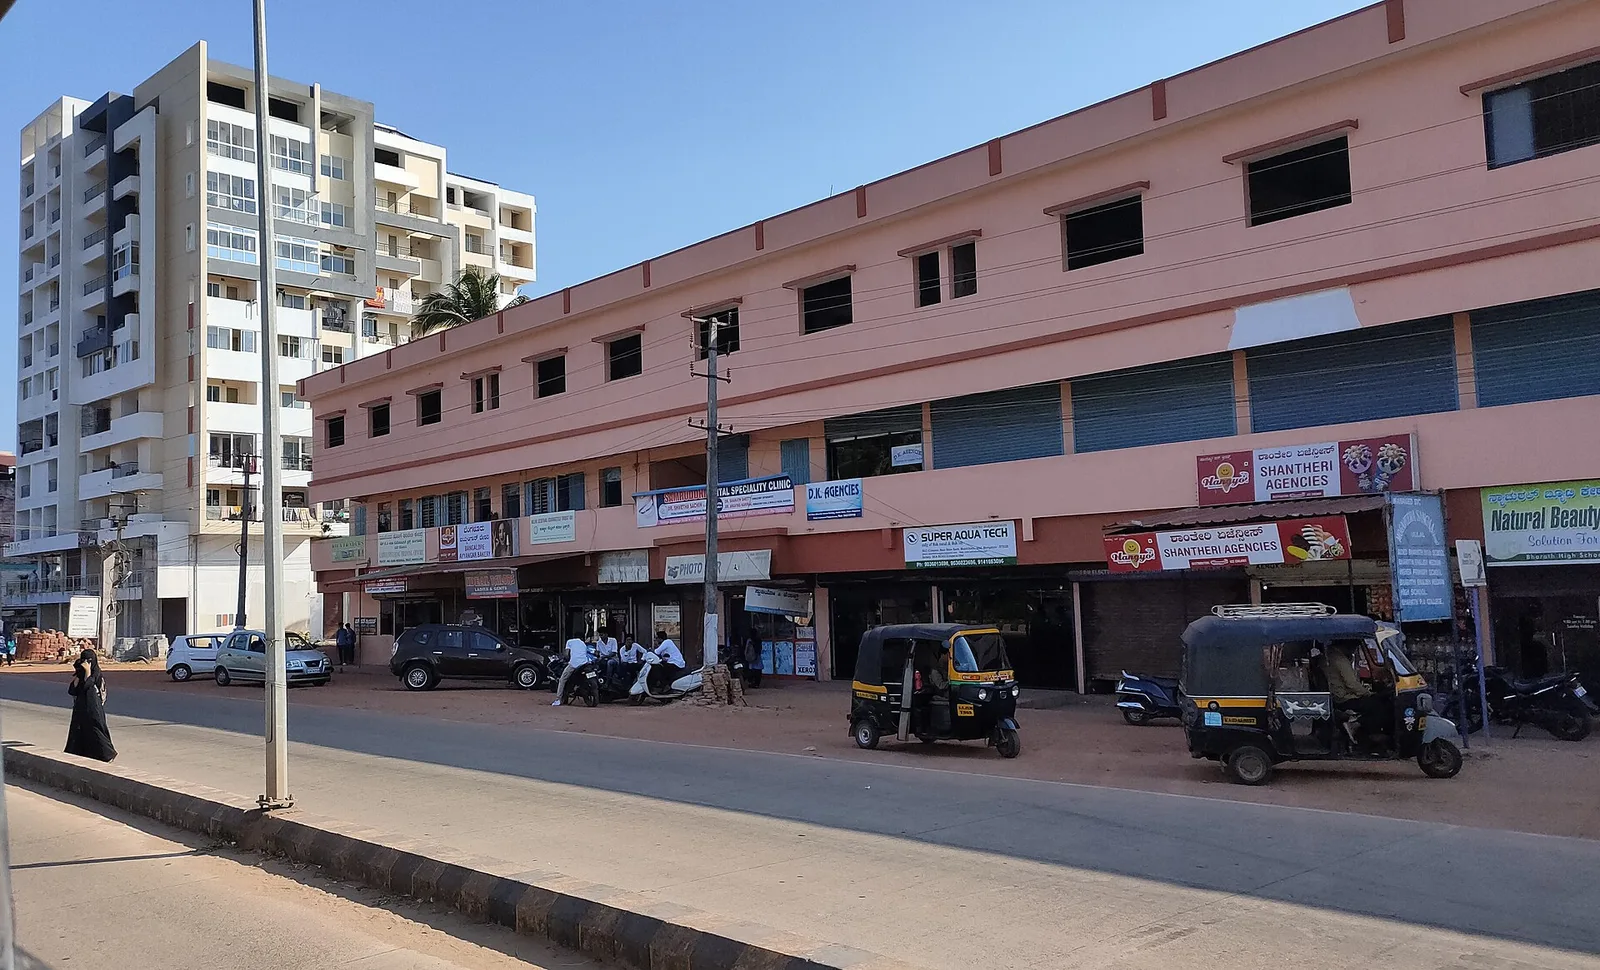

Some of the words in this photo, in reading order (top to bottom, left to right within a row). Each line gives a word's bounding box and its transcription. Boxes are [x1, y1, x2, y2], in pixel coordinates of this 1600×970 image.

[1260, 460, 1333, 477] SHANTHERI
[731, 482, 767, 496] SPECIALITY
[768, 479, 792, 491] CLINIC
[1266, 475, 1329, 490] AGENCIES
[824, 483, 860, 498] AGENCIES
[1491, 507, 1546, 531] Natural
[1550, 505, 1600, 530] Beauty
[921, 531, 952, 542] SUPER
[954, 530, 981, 540] AQUA
[982, 528, 1008, 538] TECH
[1170, 533, 1212, 543] ಶಾಂತೇರಿ
[1528, 535, 1572, 547] Solution
[1575, 532, 1598, 545] For
[464, 543, 485, 552] BANGALORE
[1163, 545, 1224, 558] SHANTHERI
[1224, 541, 1278, 554] AGENCIES
[679, 562, 703, 575] PHOTO
